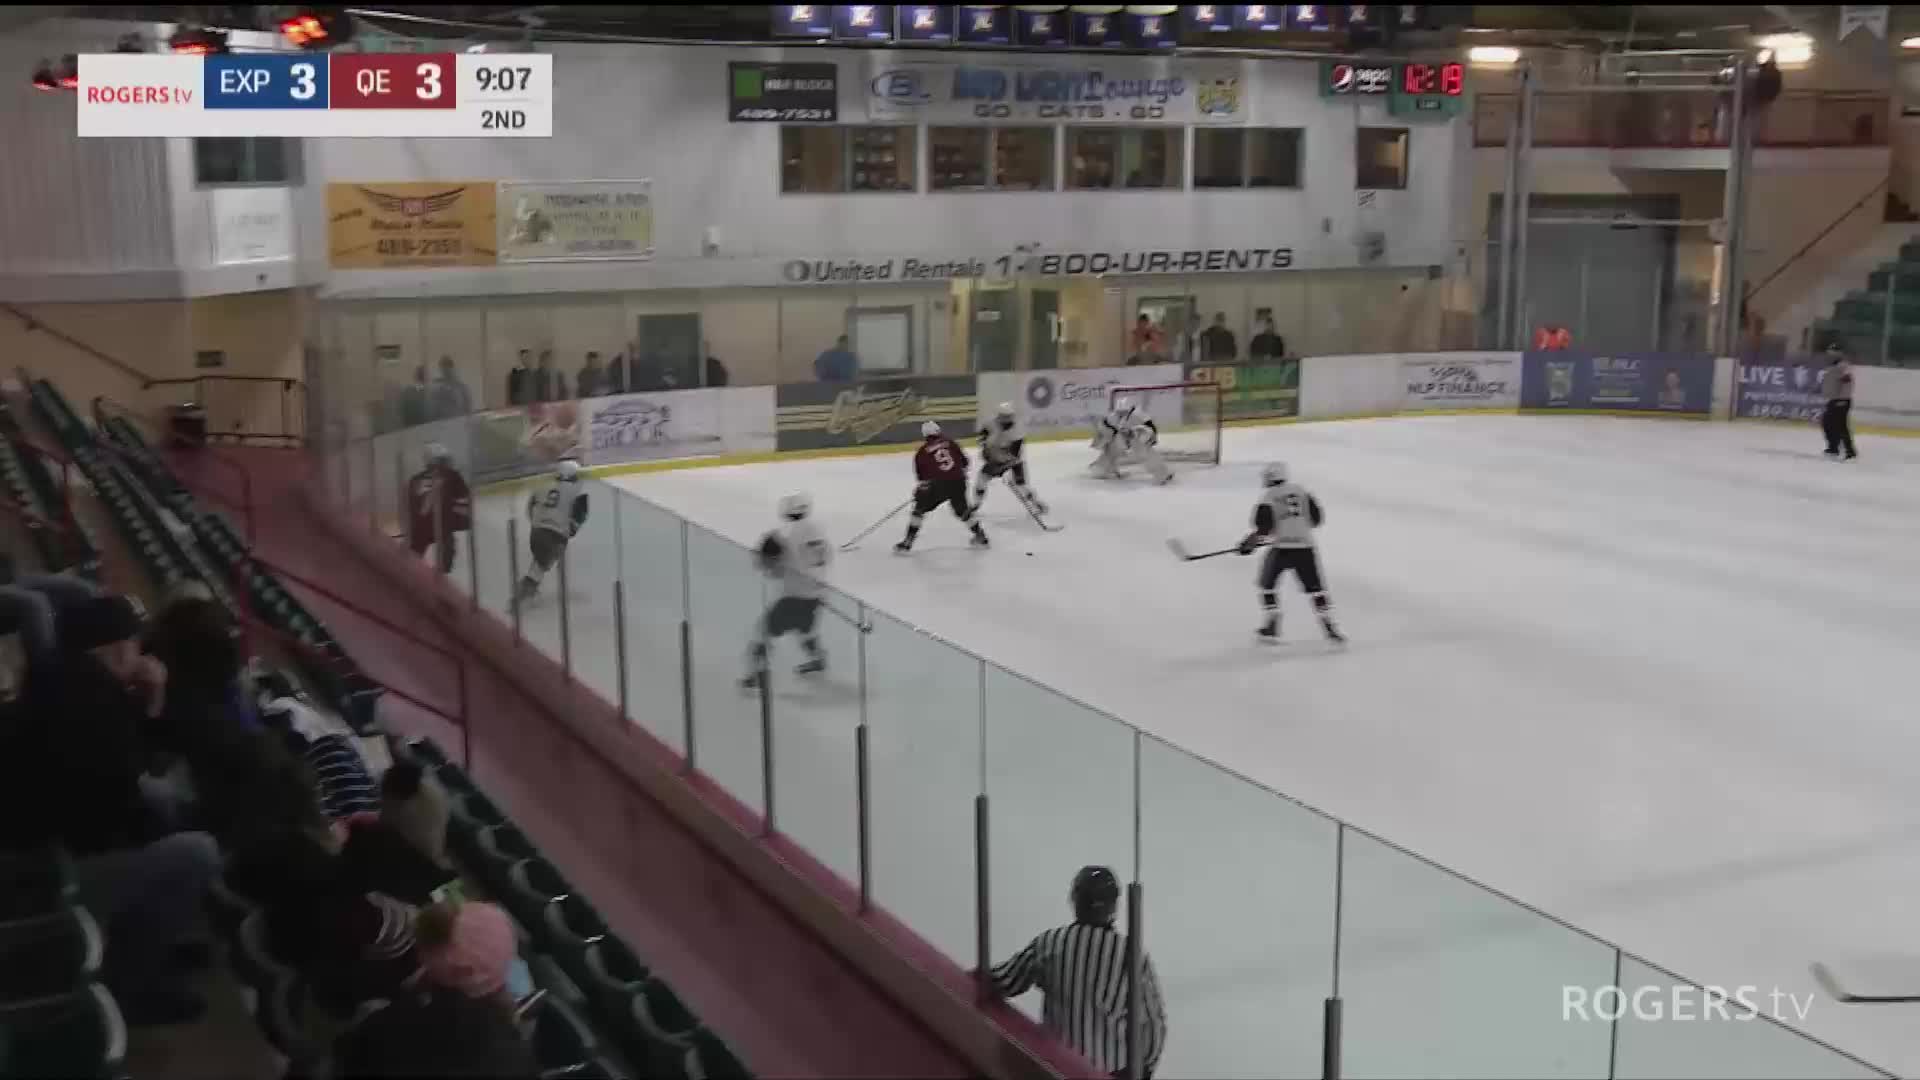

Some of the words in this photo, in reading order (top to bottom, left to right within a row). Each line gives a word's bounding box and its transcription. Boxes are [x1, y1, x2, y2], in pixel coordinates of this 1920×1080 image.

[974, 104, 1011, 118] GO
[1039, 104, 1105, 118] CATS
[1130, 105, 1165, 119] GO
[814, 257, 892, 282] United
[903, 255, 986, 281] Rentals
[1737, 366, 1785, 385] LIVE
[934, 450, 956, 471] 9
